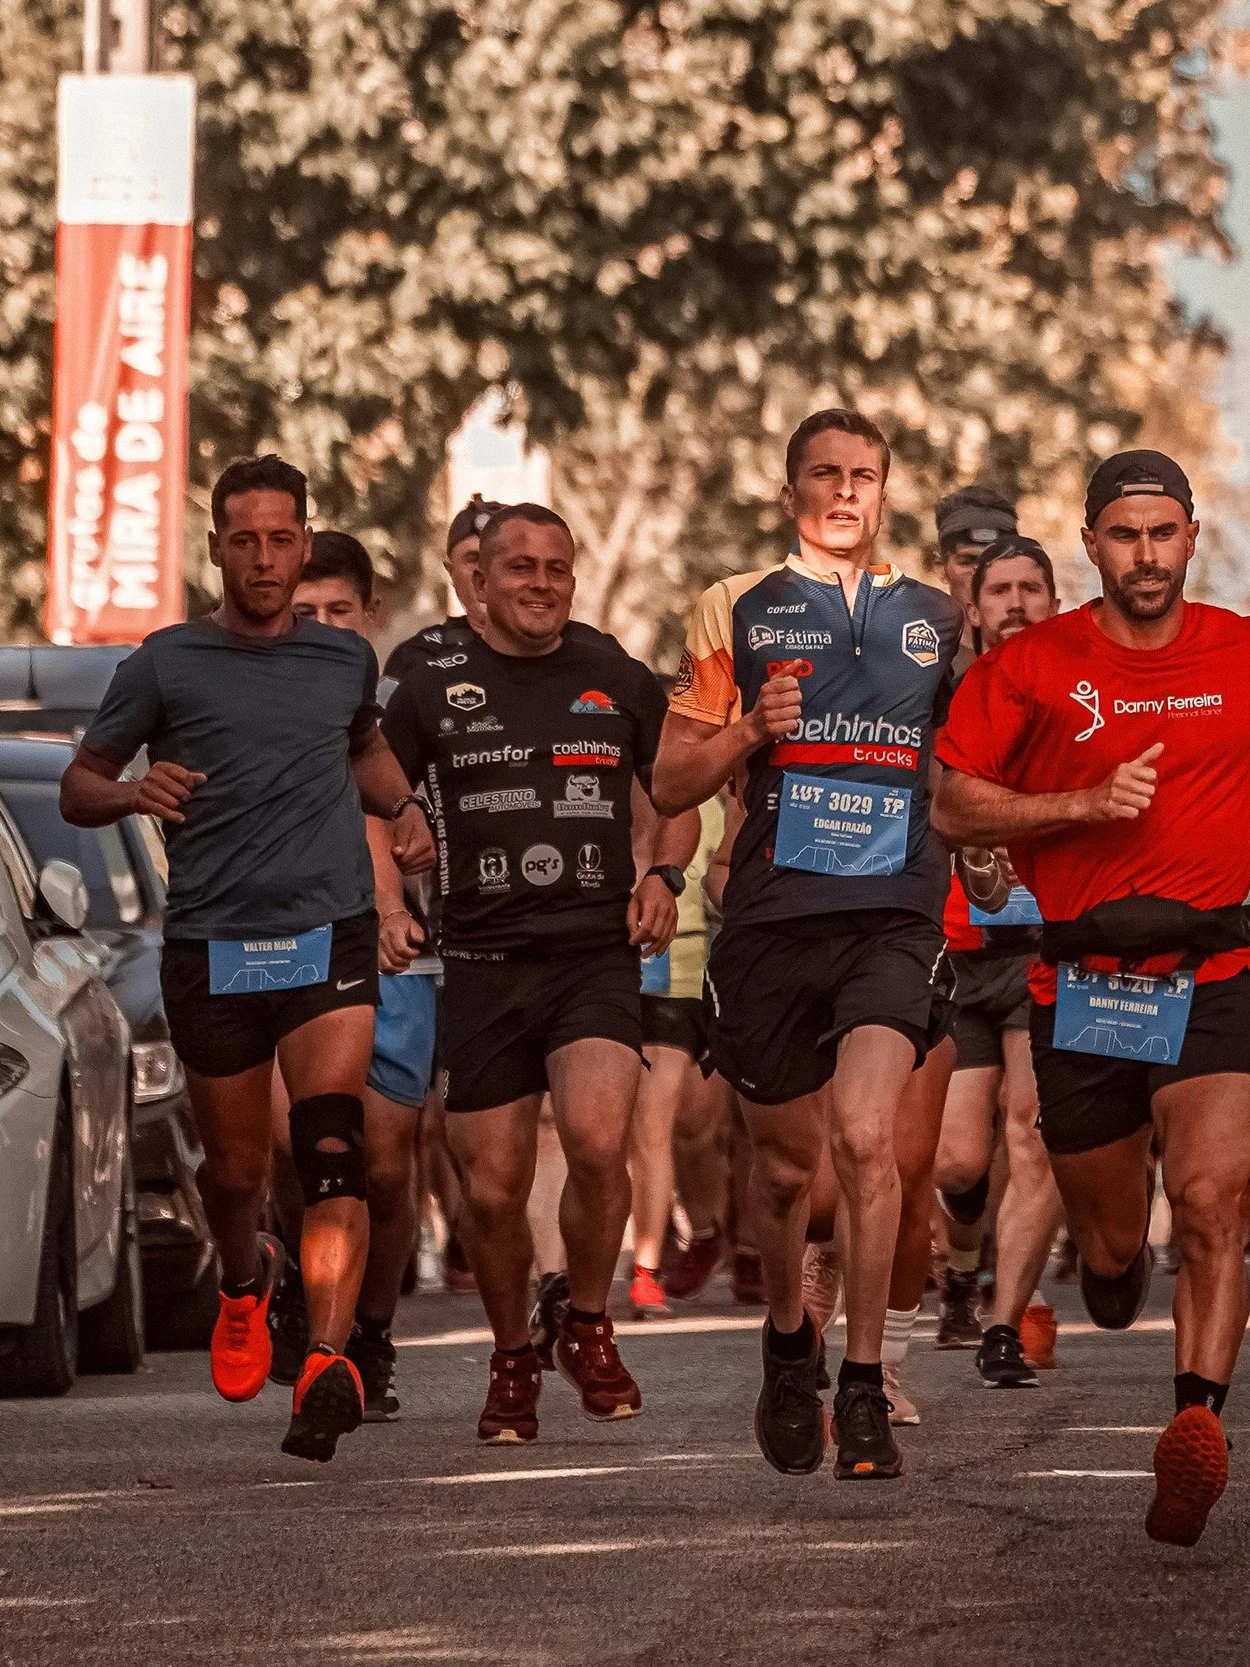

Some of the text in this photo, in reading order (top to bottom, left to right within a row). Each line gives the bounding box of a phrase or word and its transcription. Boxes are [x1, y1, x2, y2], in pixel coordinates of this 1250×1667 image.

[118, 251, 168, 377] AIRE
[114, 387, 164, 462] DE
[110, 471, 161, 609] MIRA
[766, 602, 808, 614] COFIDES
[776, 629, 832, 645] Fátima
[427, 654, 468, 669] NEO
[1113, 693, 1222, 714] Danny Ferreira
[775, 712, 921, 748] oelhinhos
[452, 745, 534, 768] transfor
[552, 740, 621, 757] coelhinhos
[853, 748, 913, 766] trucks
[462, 791, 533, 808] CELESTINO
[790, 784, 824, 803] LUT
[829, 792, 873, 815] 3029
[883, 798, 905, 814] TP
[814, 818, 841, 831] EDGAR
[242, 941, 273, 952] VALTER
[1089, 996, 1158, 1016] DANNY FERREIRA
